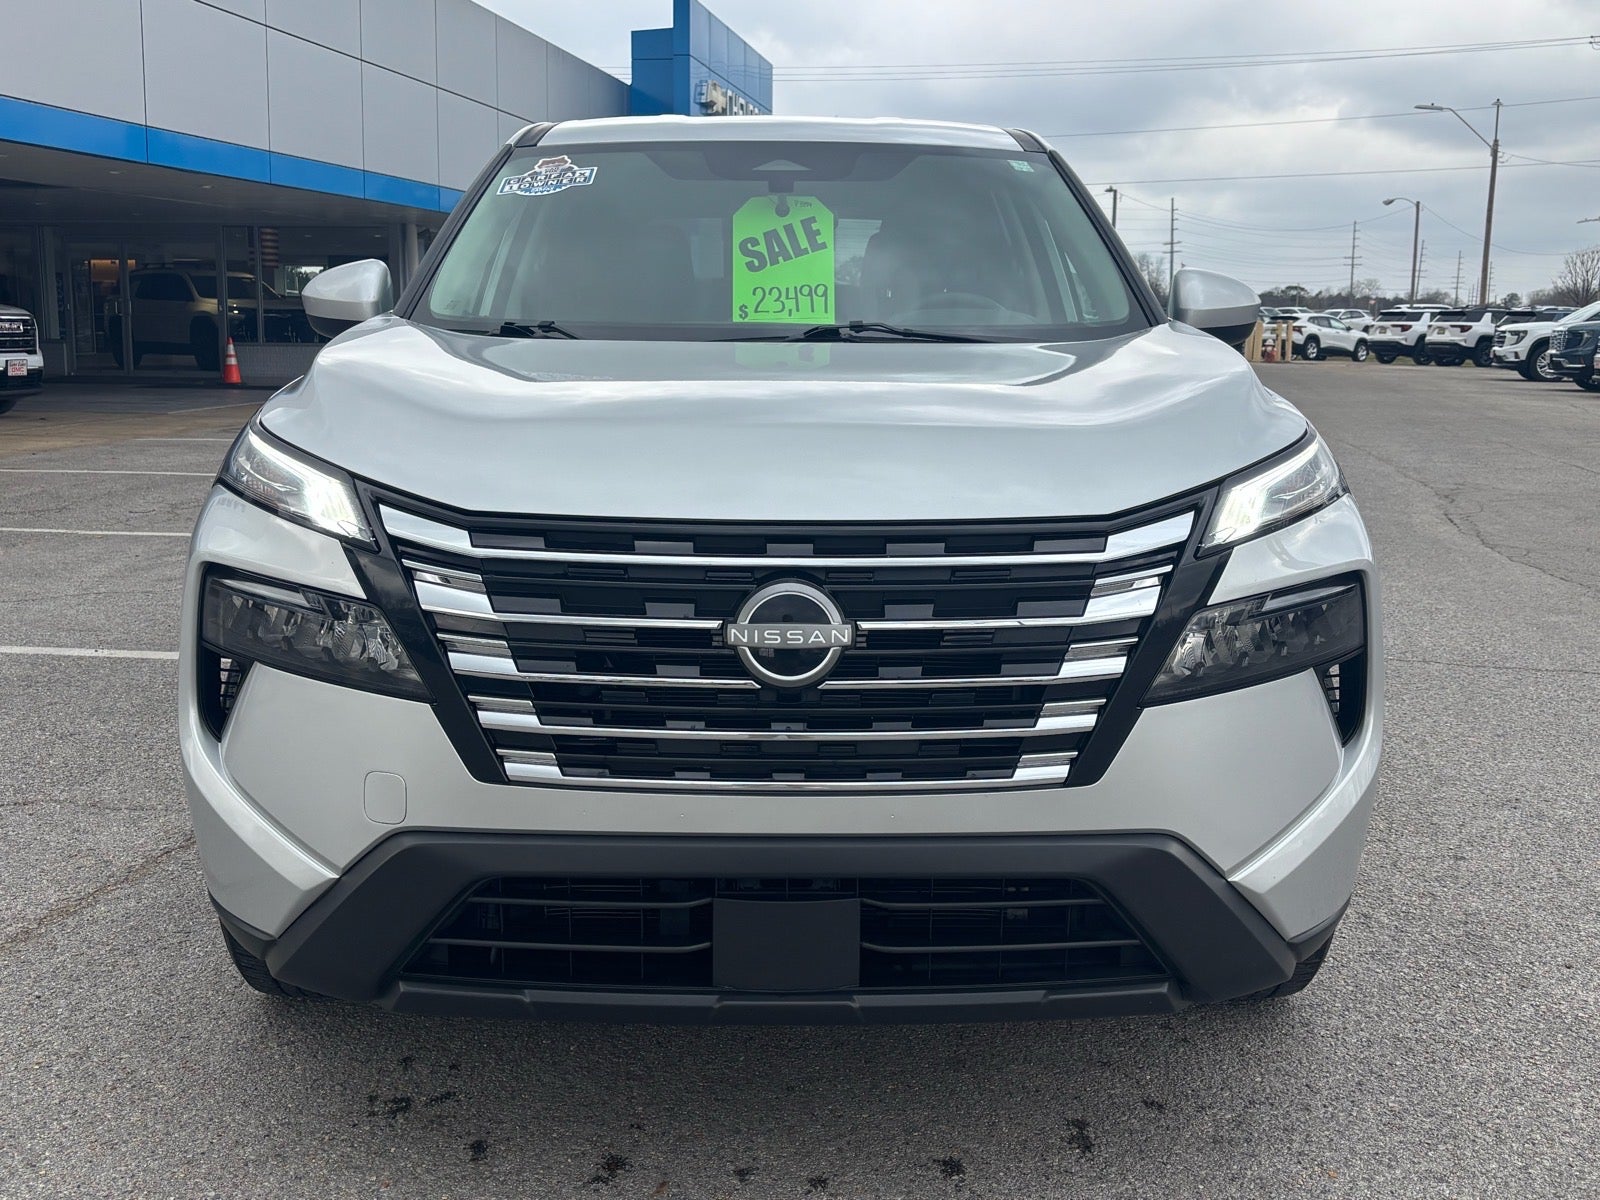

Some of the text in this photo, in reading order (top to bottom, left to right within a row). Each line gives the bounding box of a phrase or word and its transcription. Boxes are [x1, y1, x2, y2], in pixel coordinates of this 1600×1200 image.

[508, 170, 588, 185] CARFAX
[738, 215, 828, 273] SALE
[730, 628, 849, 644] NISSAN
